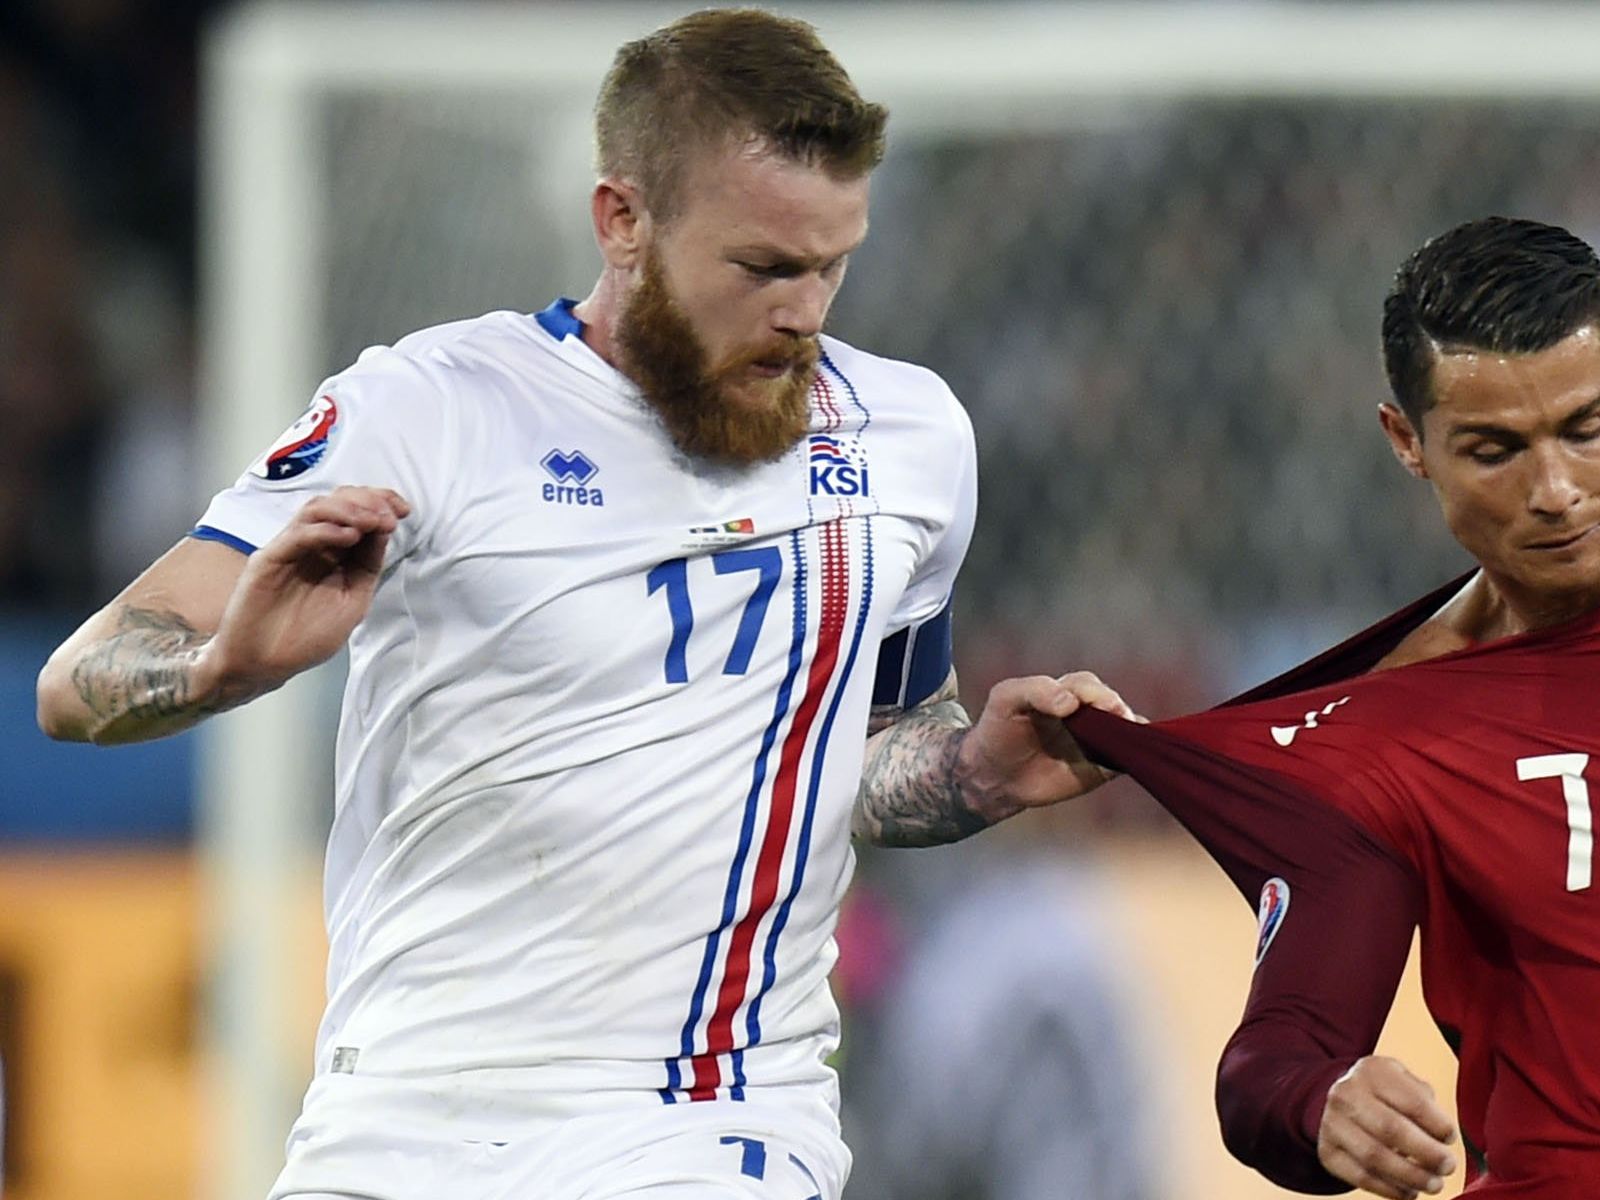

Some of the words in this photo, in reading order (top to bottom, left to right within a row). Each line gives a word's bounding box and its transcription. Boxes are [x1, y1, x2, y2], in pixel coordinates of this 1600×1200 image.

[542, 483, 604, 507] errea
[647, 545, 783, 684] 17
[1516, 753, 1594, 892] 7
